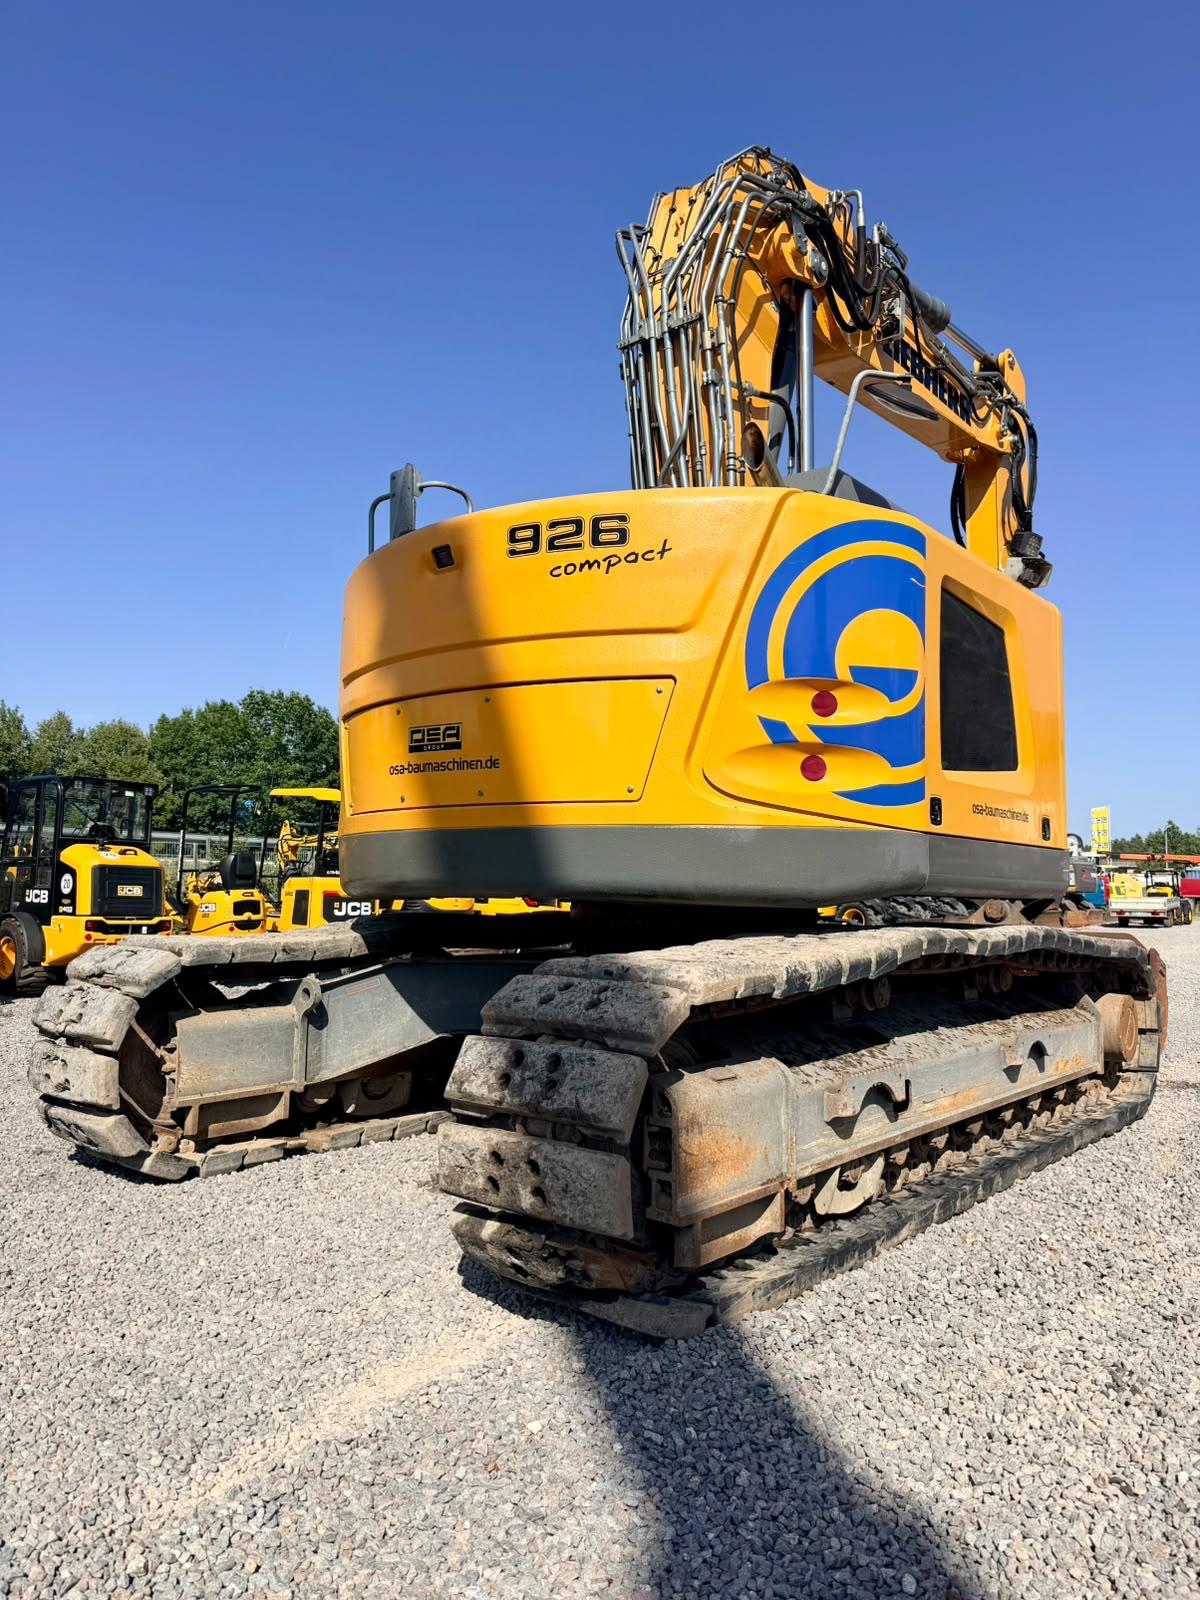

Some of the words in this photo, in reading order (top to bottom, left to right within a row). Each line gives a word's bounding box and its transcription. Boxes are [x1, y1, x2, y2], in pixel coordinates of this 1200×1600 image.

[506, 512, 630, 558] 926
[549, 538, 672, 578] compact
[389, 755, 500, 775] osa-baumaschinen.de
[972, 803, 1029, 823] osa-baumaschinen.de
[63, 878, 71, 889] 20
[119, 886, 142, 895] JCB
[25, 889, 49, 903] JCB
[199, 903, 216, 912] JCB
[333, 902, 372, 916] JCB
